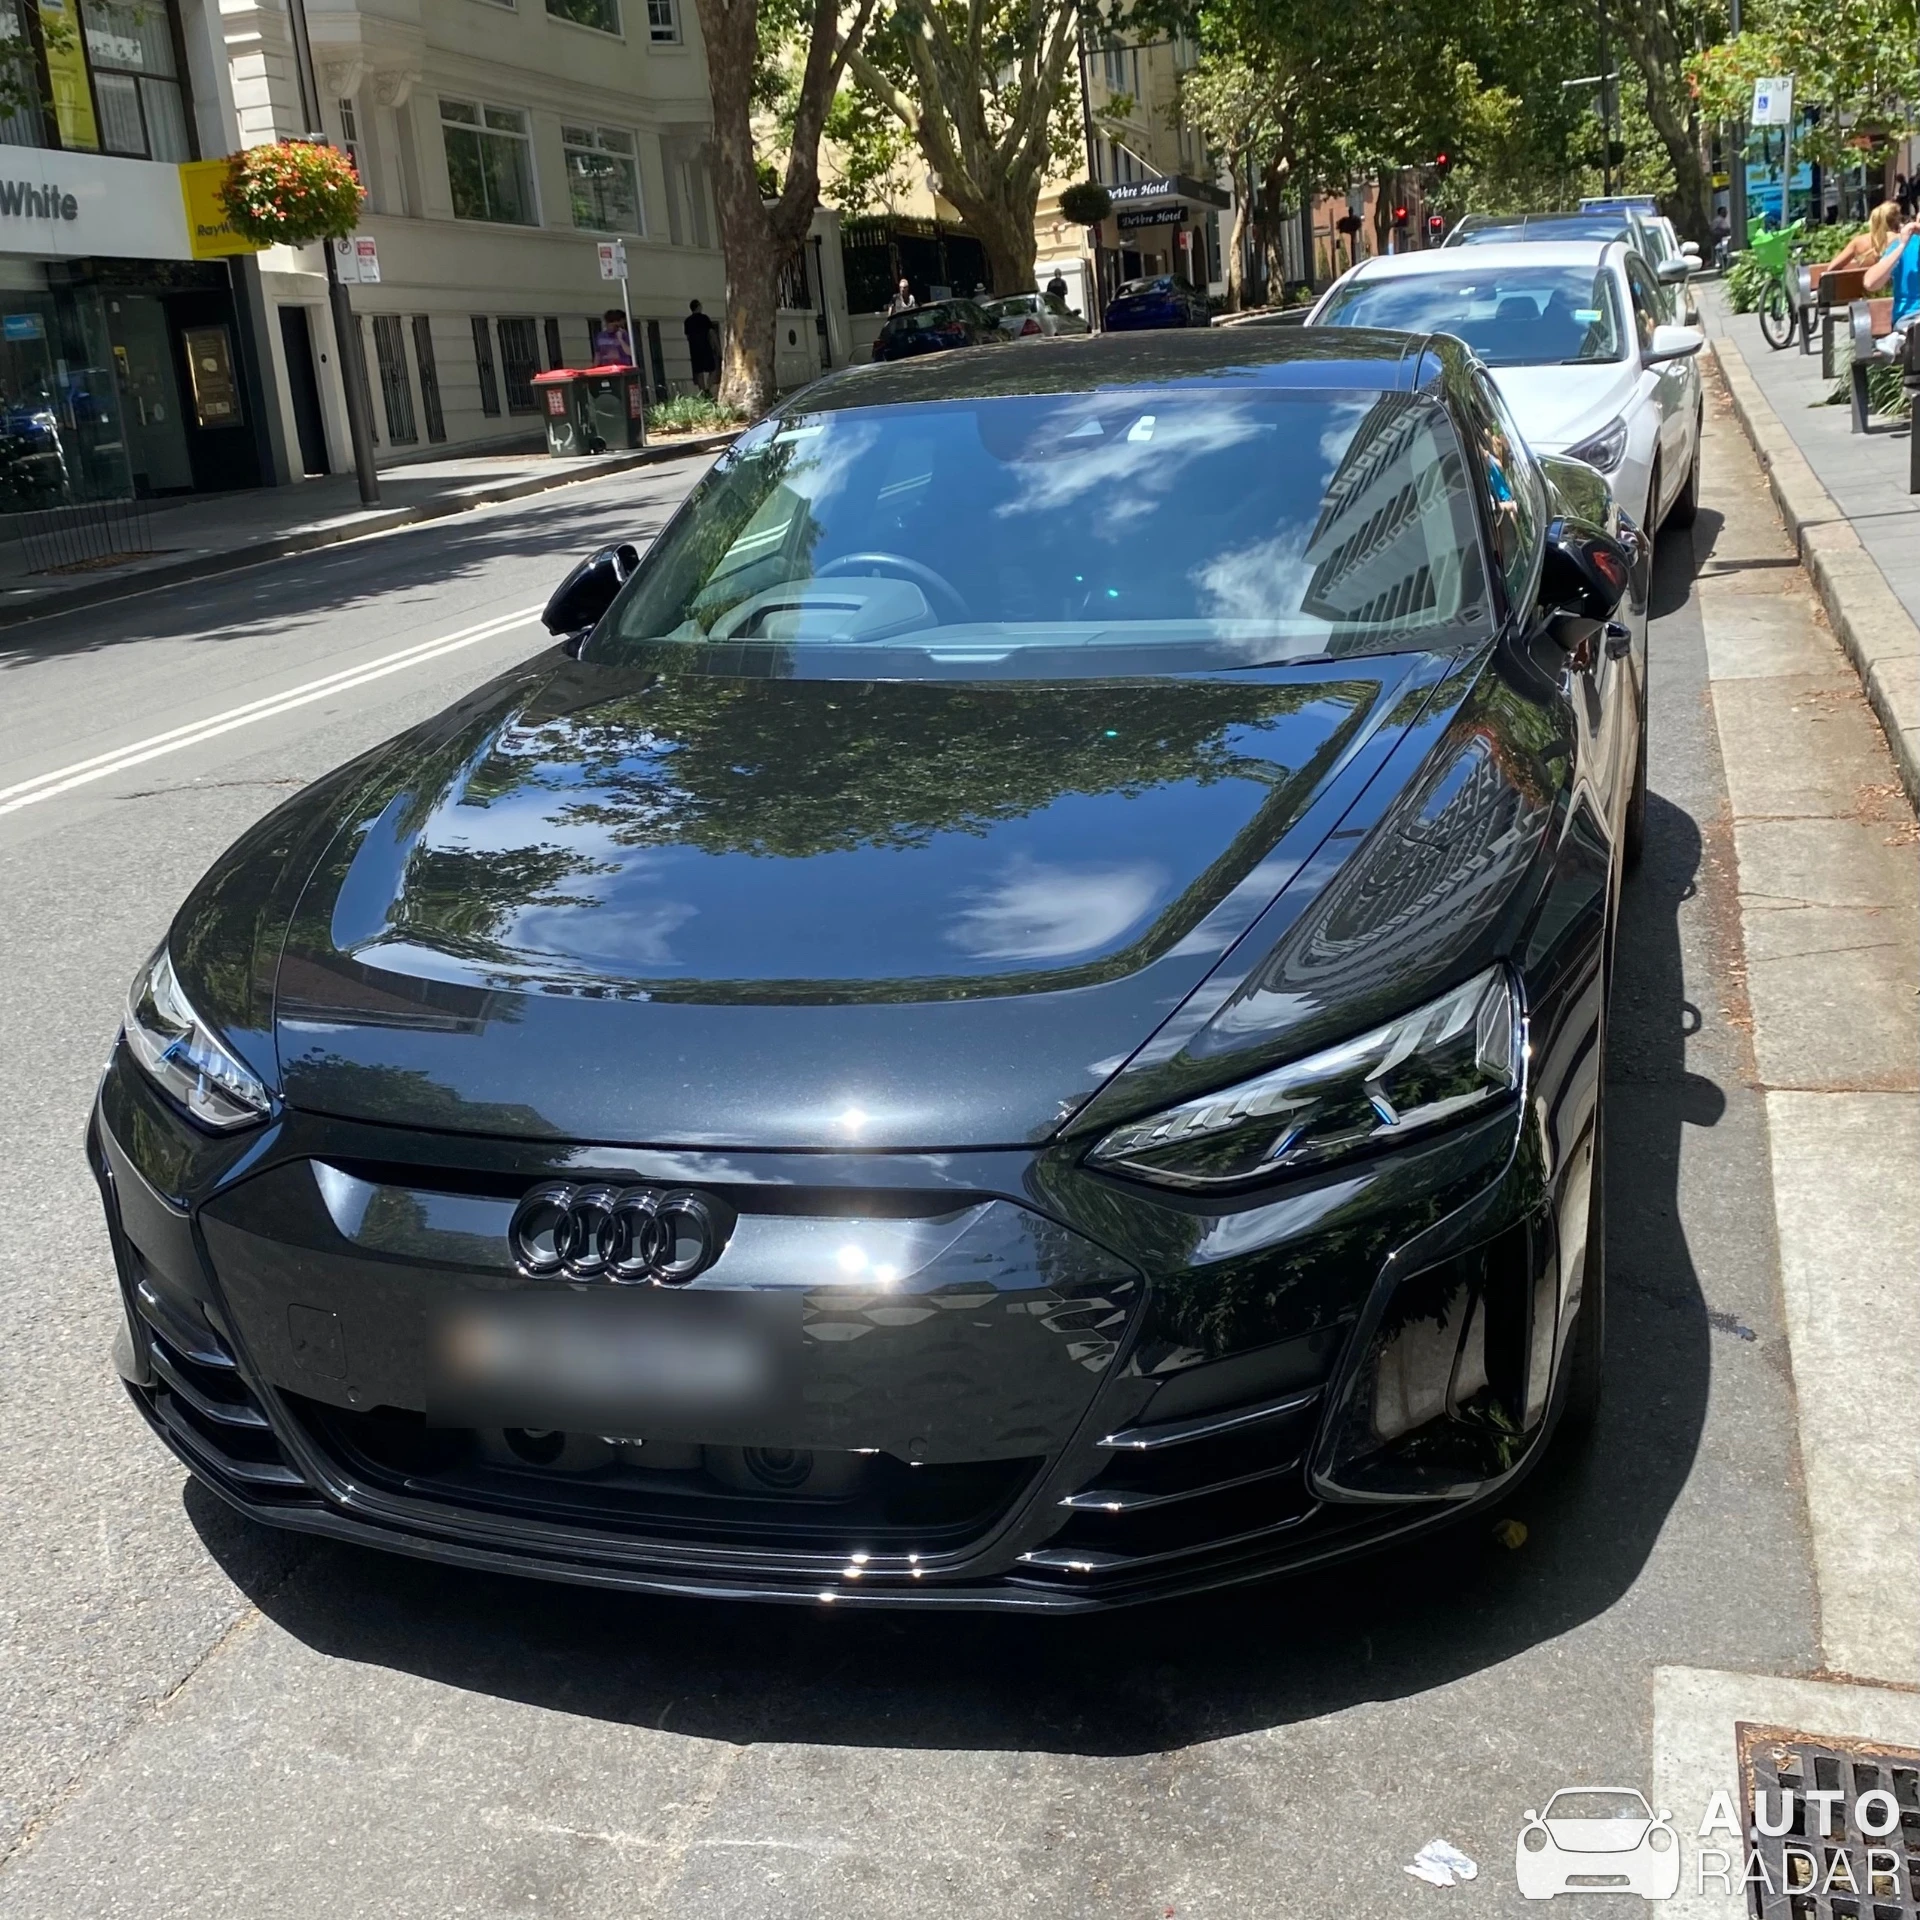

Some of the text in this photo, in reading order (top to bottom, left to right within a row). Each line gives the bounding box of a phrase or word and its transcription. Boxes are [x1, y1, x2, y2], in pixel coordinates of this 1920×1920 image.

[1758, 80, 1773, 93] 2P
[1141, 181, 1169, 196] Hotel
[0, 180, 78, 221] White
[1122, 210, 1181, 226] DeVere Hotel
[197, 220, 232, 238] RayW
